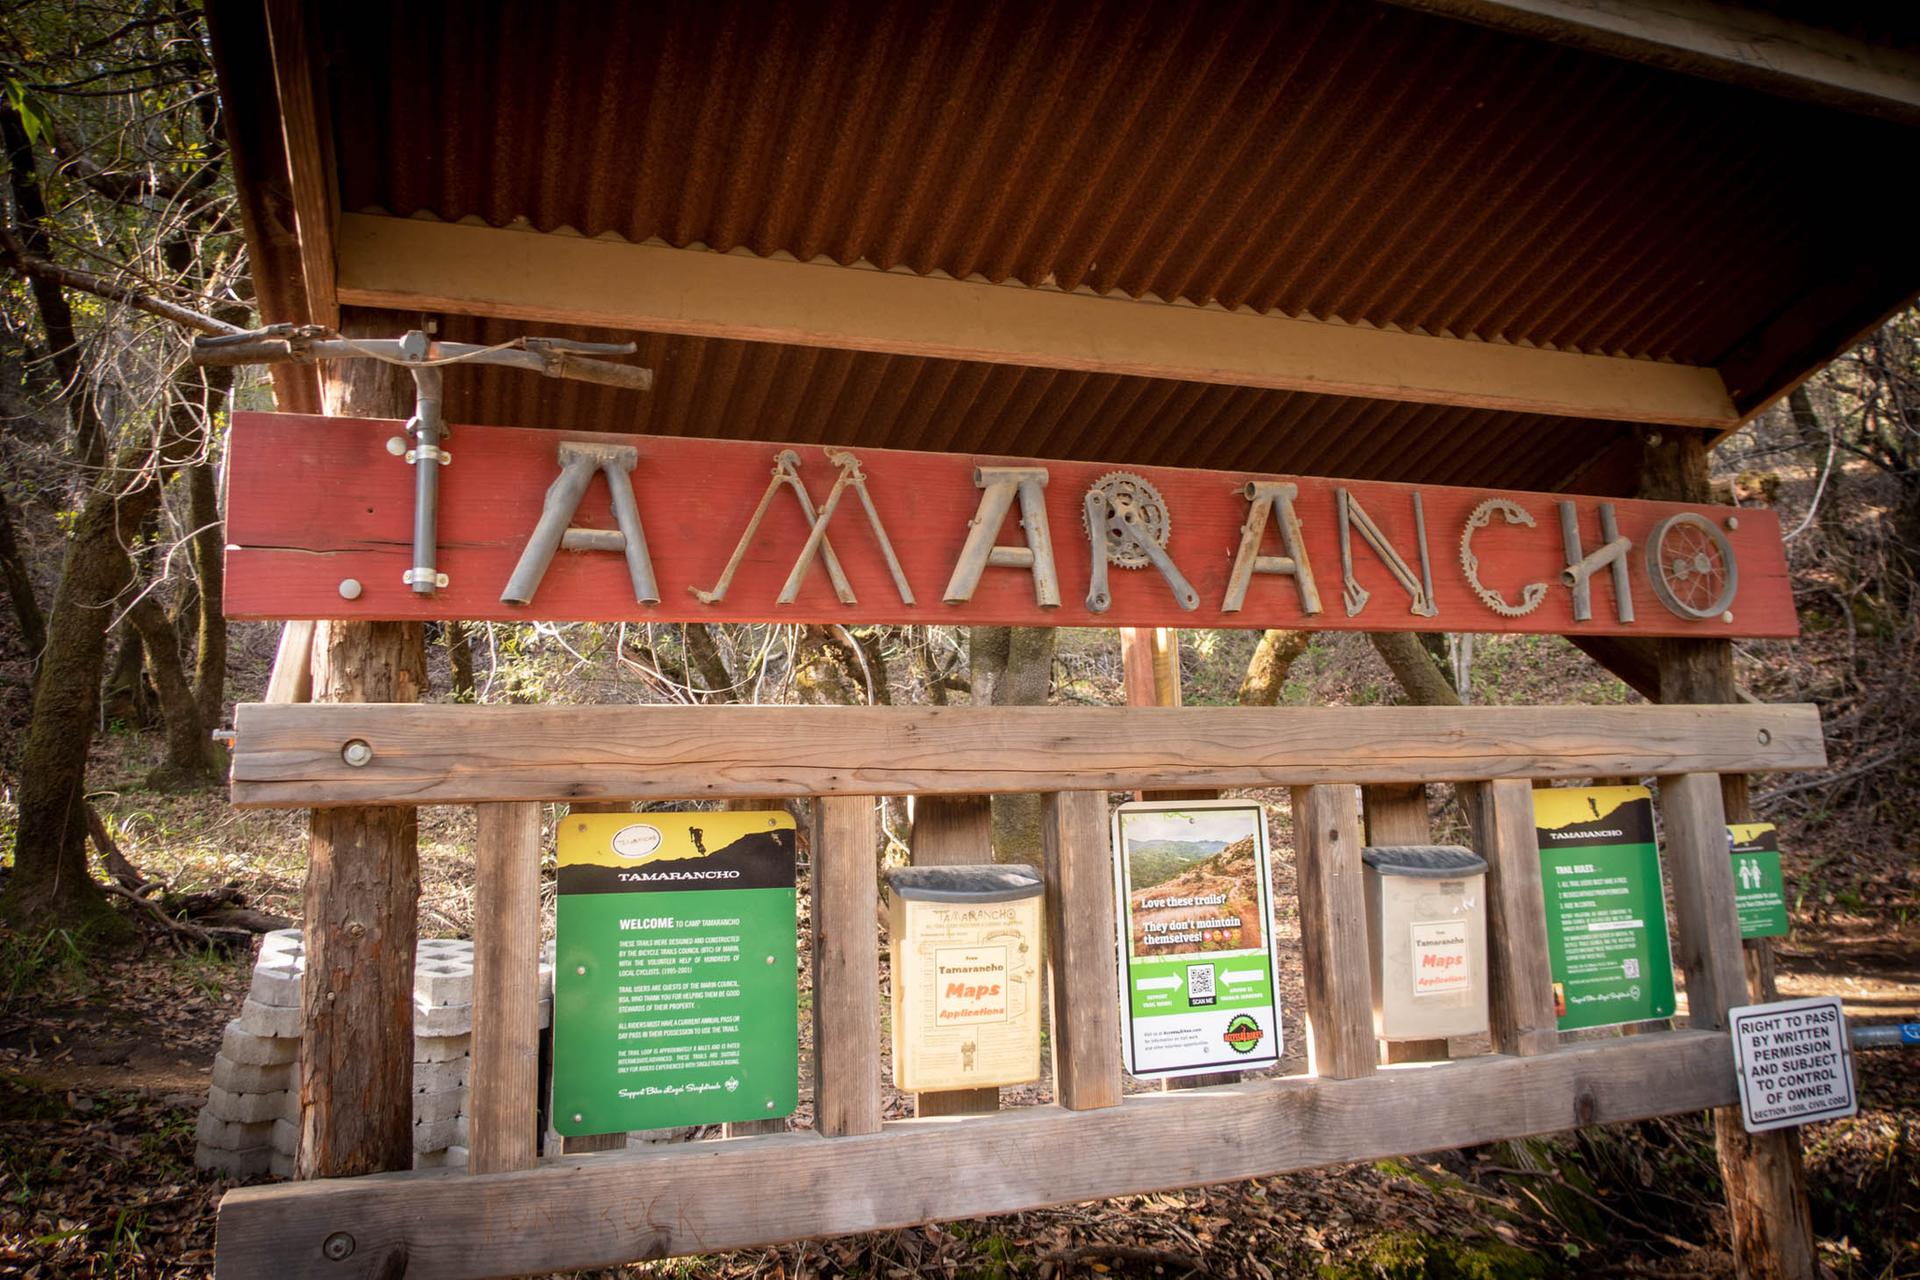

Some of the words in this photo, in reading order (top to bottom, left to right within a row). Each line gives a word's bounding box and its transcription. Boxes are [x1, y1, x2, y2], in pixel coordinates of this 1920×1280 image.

[191, 323, 1738, 622] TAMARANCHO
[1550, 830, 1623, 839] TAMARANCHO
[618, 871, 740, 881] TAMARANCHO
[1142, 899, 1166, 908] Love
[1167, 897, 1193, 907] these
[1194, 894, 1226, 905] trails?
[620, 917, 674, 930] WELCOME
[703, 918, 740, 926] TAMARANCHO
[1143, 921, 1167, 933] They
[1169, 919, 1195, 929] don't
[1196, 916, 1241, 928] maintain
[1144, 931, 1202, 945] themselves!
[939, 964, 1003, 974] Tamarancho
[1422, 954, 1463, 968] Maps
[946, 982, 1000, 1000] Maps
[939, 1008, 1004, 1019] Applications
[1741, 1020, 1780, 1034] RIGHT
[1785, 1016, 1802, 1028] TO
[1805, 1010, 1836, 1025] PASS
[1752, 1035, 1769, 1047] BY
[1773, 1026, 1830, 1044] WRITTEN
[1754, 1041, 1831, 1062] PERMISSION
[1752, 1064, 1778, 1078] AND
[1782, 1054, 1838, 1072] SUBJECT
[1757, 1079, 1774, 1091] TO
[1778, 1068, 1837, 1088] CONTROL
[1767, 1093, 1783, 1104] OF
[1787, 1084, 1832, 1101] OWNER
[1754, 1107, 1787, 1119] SECTION
[1808, 1100, 1827, 1110] CIVIL
[1828, 1096, 1847, 1105] CODE
